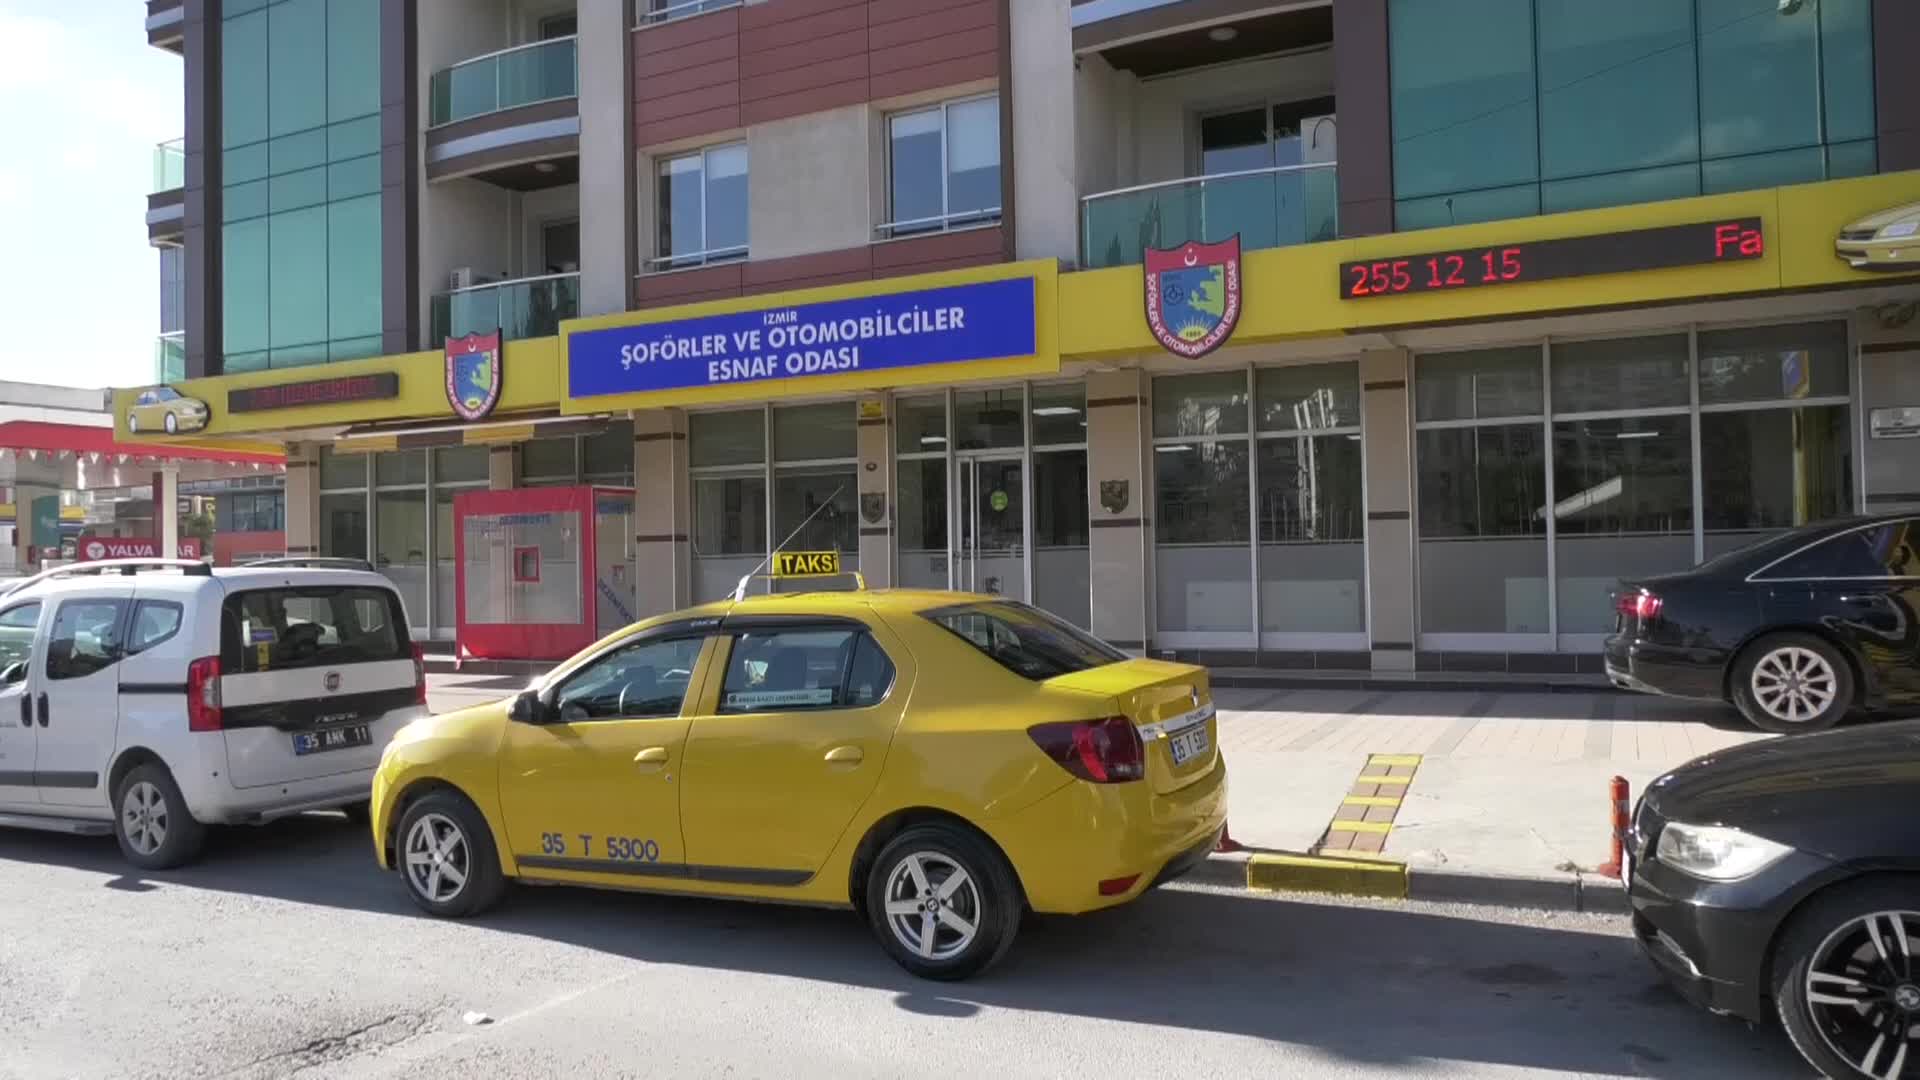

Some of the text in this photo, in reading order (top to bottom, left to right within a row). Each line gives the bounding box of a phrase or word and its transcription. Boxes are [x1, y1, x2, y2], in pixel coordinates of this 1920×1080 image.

[1351, 224, 1763, 296] 255 12 15 Fa
[763, 310, 798, 326] İZMİR
[621, 304, 965, 371] ŞOFÖRLER VE OTOMOBİLCİLER
[708, 346, 860, 382] ESNAF ODASI
[541, 832, 659, 861] 35 T 5300
